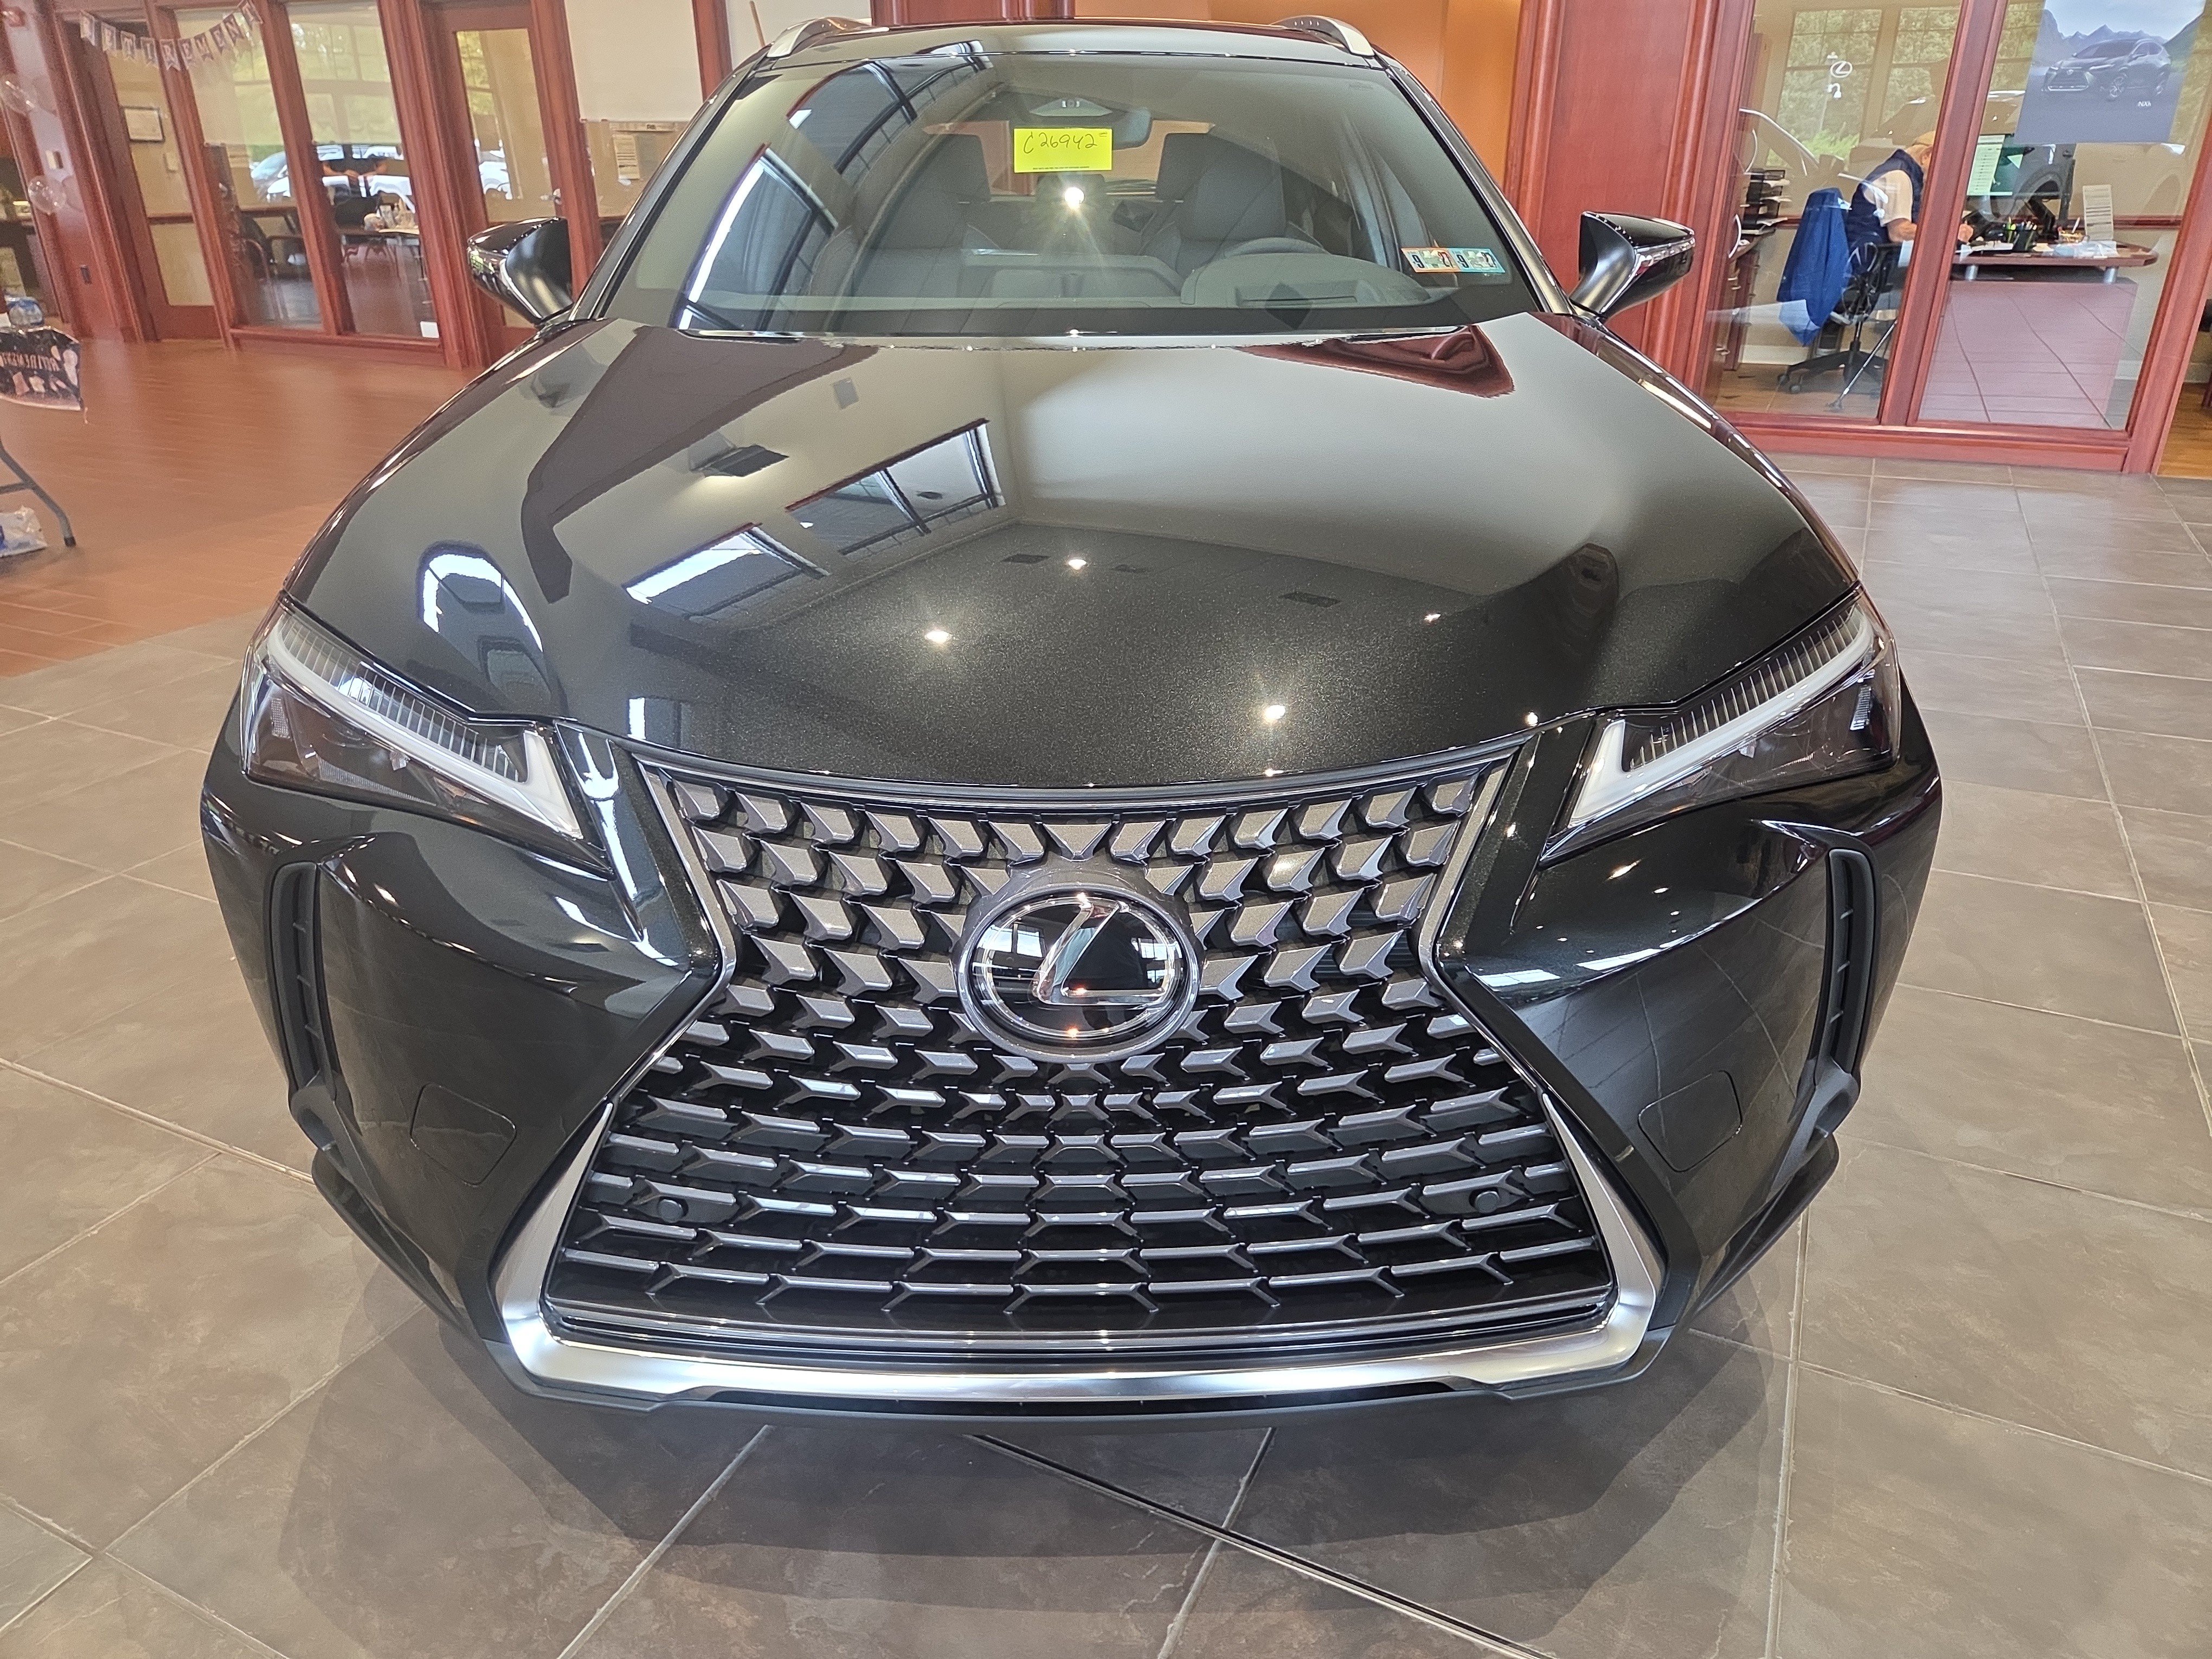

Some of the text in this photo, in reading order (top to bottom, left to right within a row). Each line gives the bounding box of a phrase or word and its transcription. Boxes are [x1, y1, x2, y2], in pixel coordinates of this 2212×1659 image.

[1023, 131, 1097, 154] C26942
[1412, 254, 1425, 268] 9
[1456, 254, 1469, 268] 9
